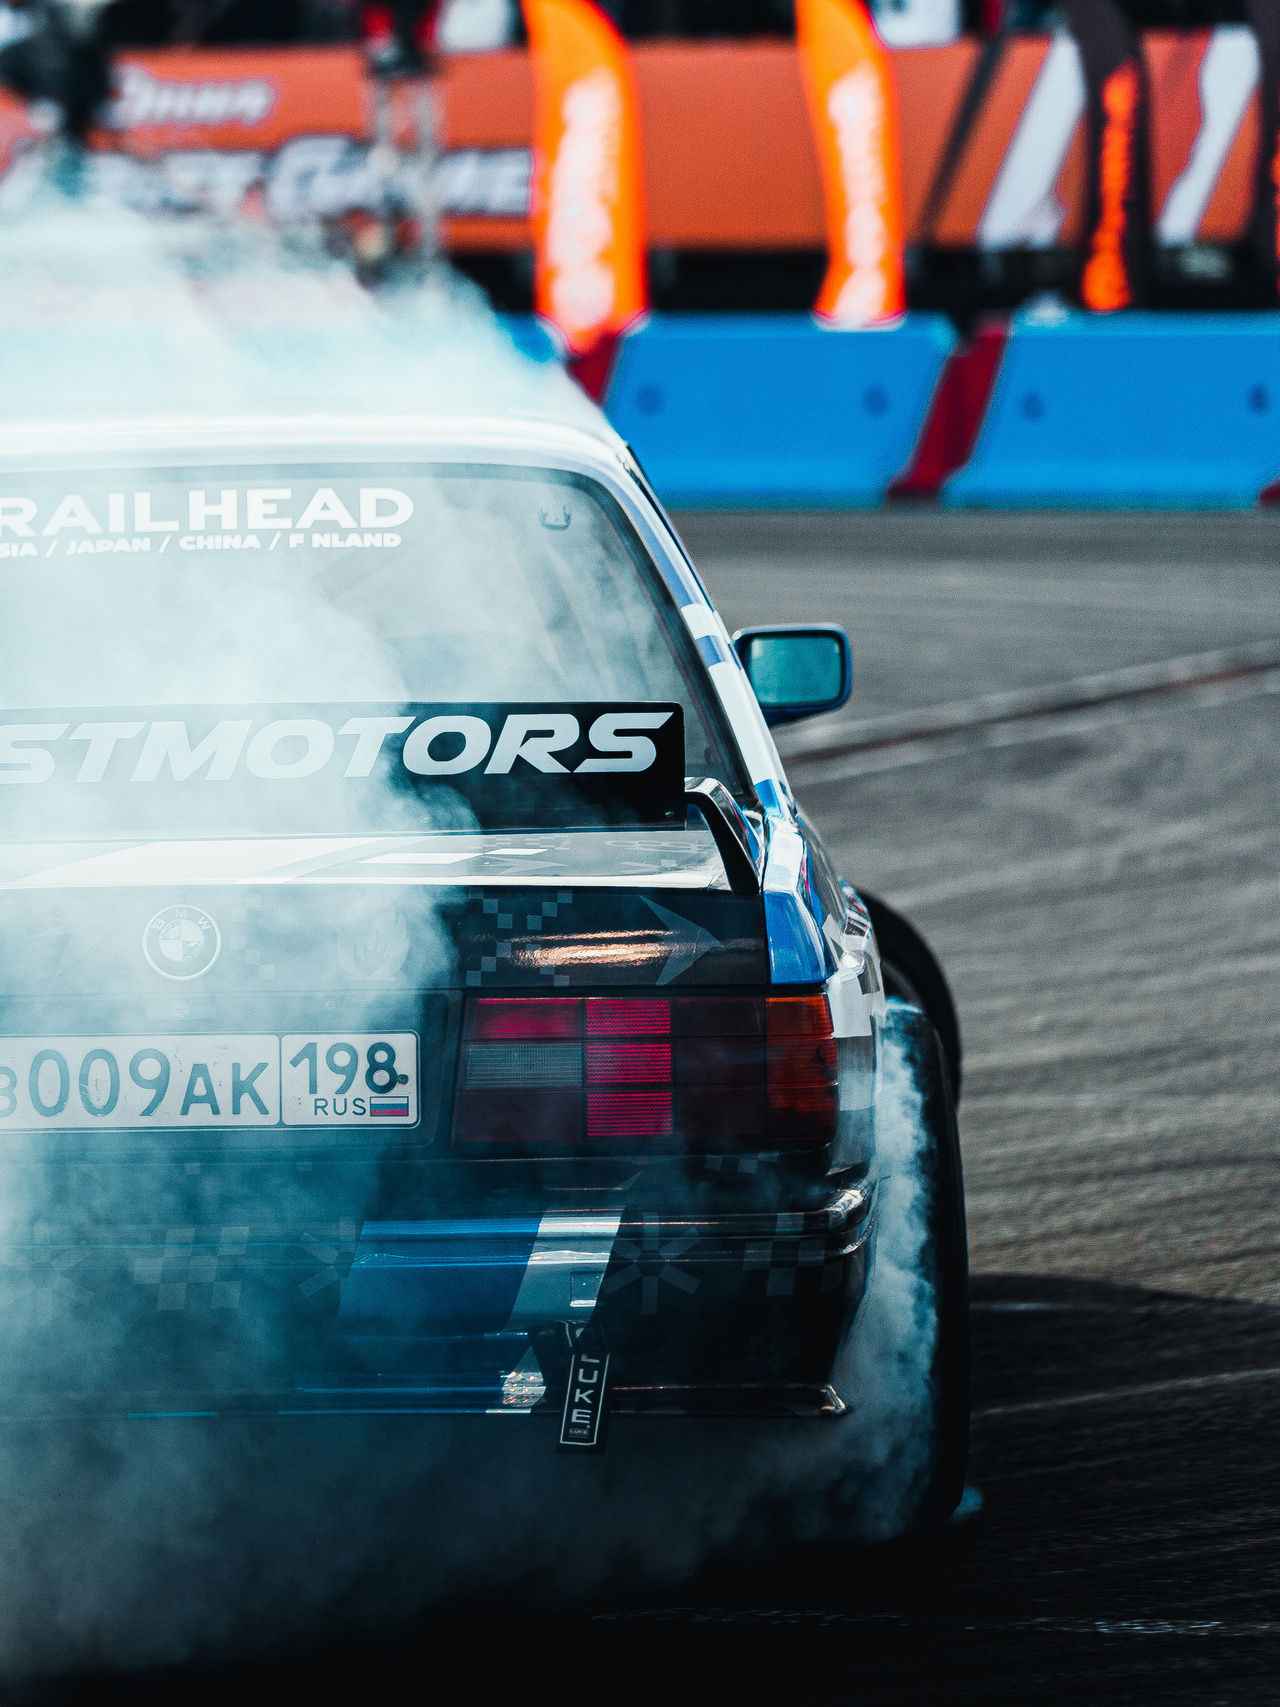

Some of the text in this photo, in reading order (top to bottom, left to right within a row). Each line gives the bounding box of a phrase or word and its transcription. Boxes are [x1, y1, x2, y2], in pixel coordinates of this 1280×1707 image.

[65, 537, 151, 555] JAPAN
[178, 532, 262, 551] CHINA
[288, 532, 402, 549] FNLAND
[151, 908, 213, 931] BMW
[289, 1042, 398, 1095] 198
[314, 1097, 367, 1117] RUS
